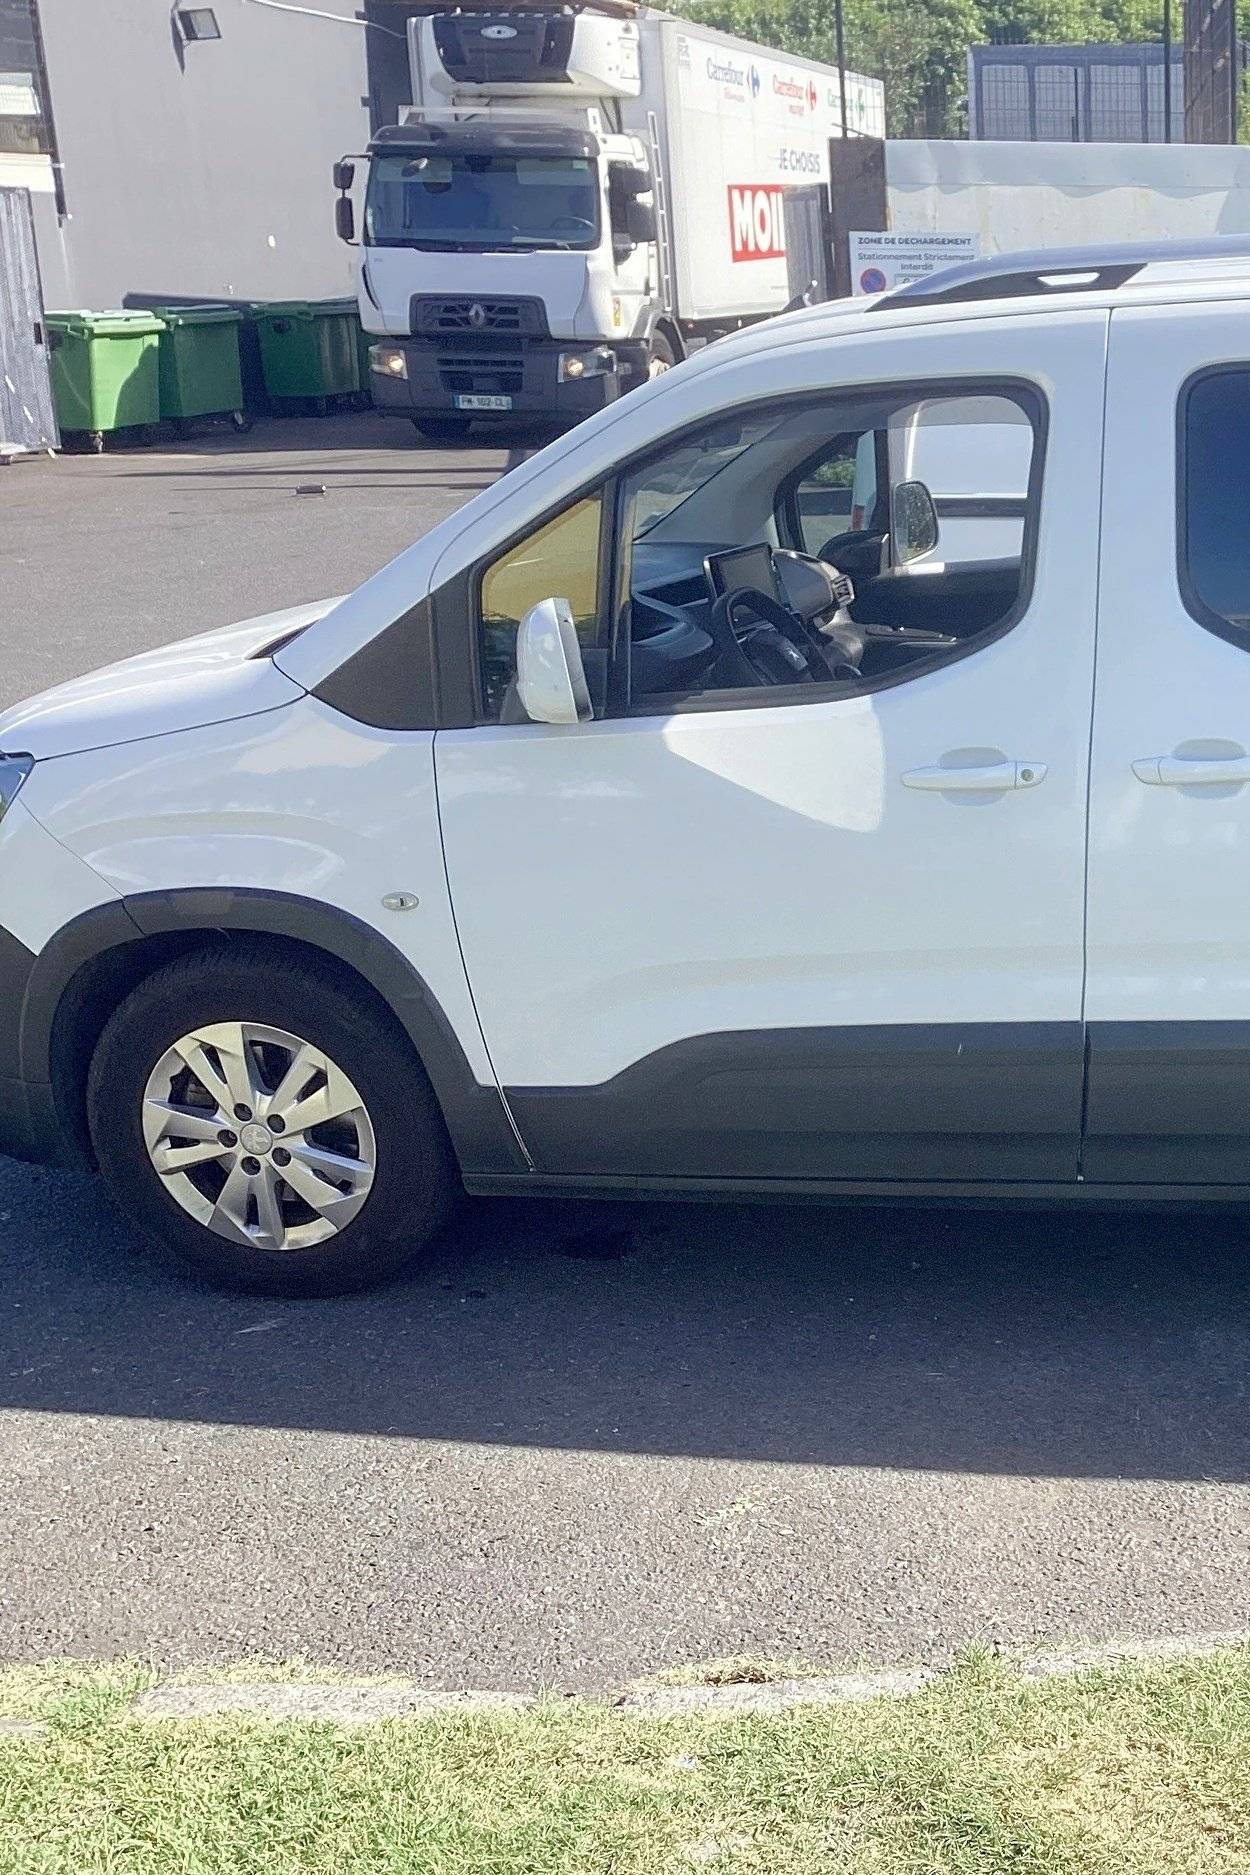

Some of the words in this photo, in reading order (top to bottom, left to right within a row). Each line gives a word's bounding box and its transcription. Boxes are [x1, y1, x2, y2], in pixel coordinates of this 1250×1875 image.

[707, 57, 744, 86] Carrefour
[858, 237, 882, 245] ZONE
[884, 237, 897, 245] DE
[858, 253, 922, 261] Stationnement
[923, 252, 975, 261] Strictement
